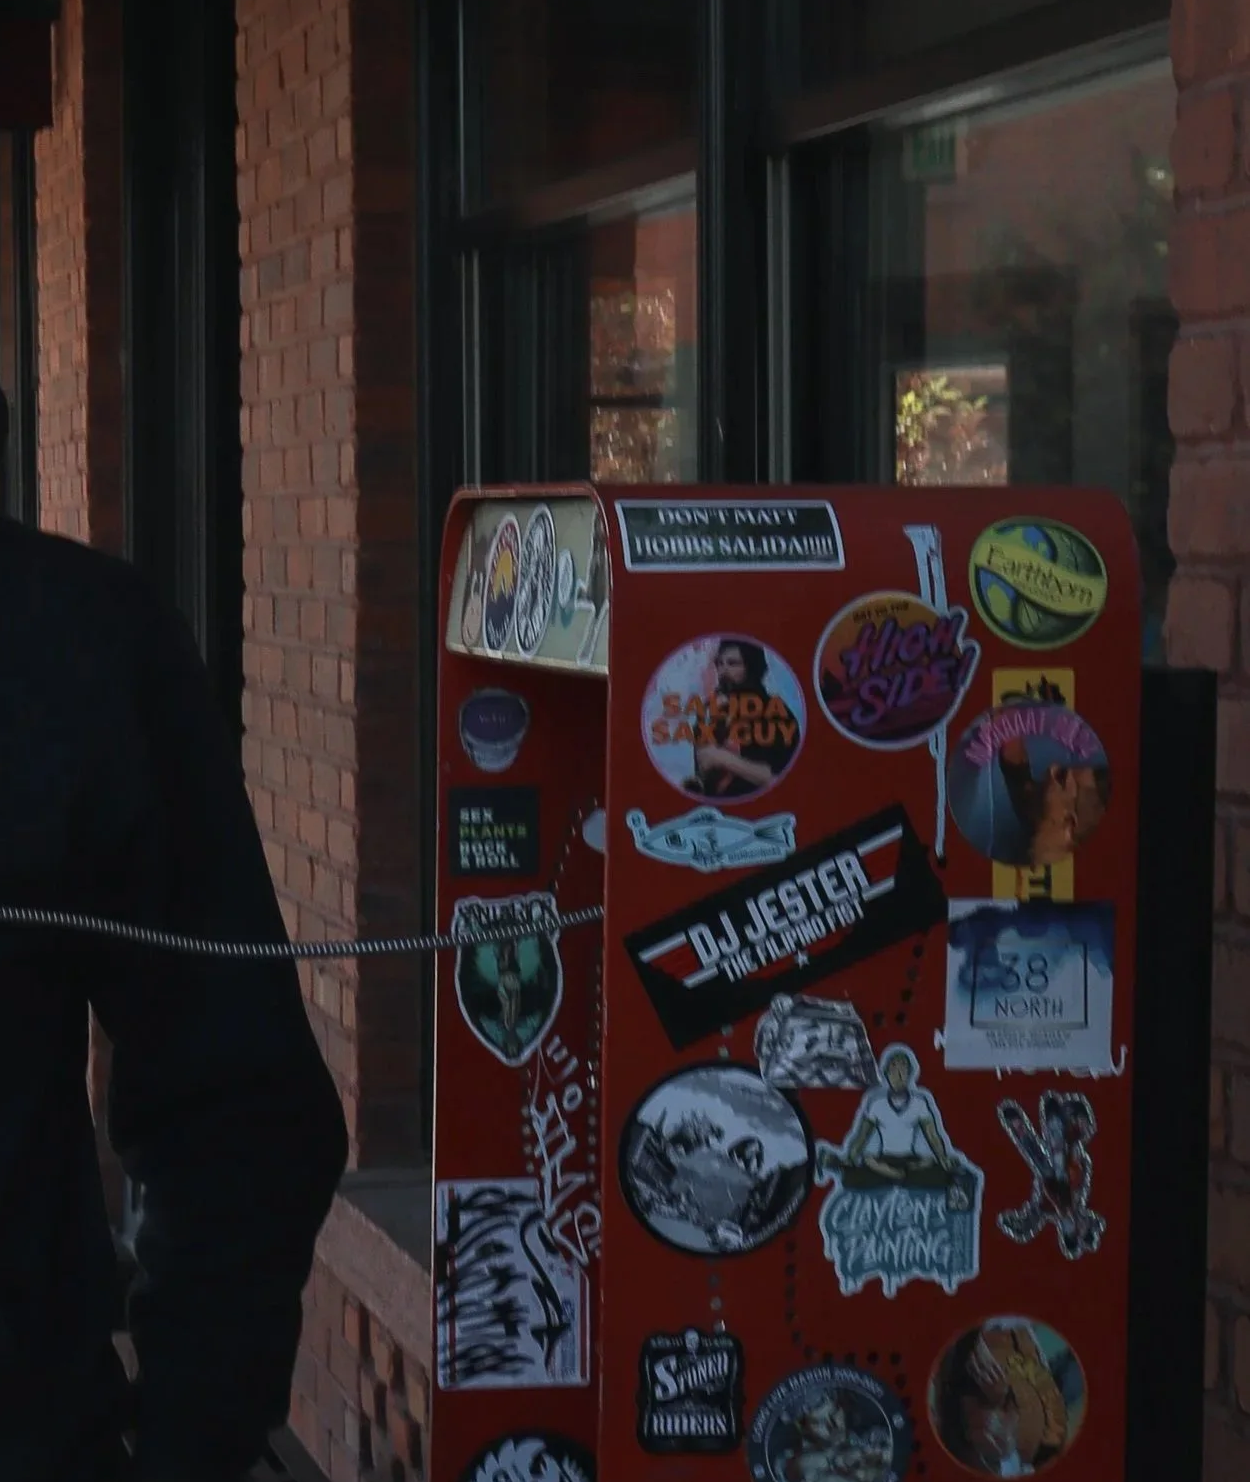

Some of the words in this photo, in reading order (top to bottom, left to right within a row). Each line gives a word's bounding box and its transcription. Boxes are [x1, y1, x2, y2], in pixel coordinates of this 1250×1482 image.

[733, 508, 798, 526] MATT
[661, 690, 788, 718] SALIDA
[651, 721, 717, 747] SAX
[727, 722, 798, 748] GUY
[459, 807, 494, 824] SEX
[459, 822, 528, 839] PLANTS
[459, 839, 508, 856] ROCK
[475, 852, 520, 869] ROLL
[688, 910, 741, 972] DJ
[744, 849, 870, 942] JESTER
[717, 942, 753, 983] THE
[750, 917, 827, 974] FILIPINO
[999, 952, 1049, 993] 38
[994, 994, 1065, 1019] NORTH
